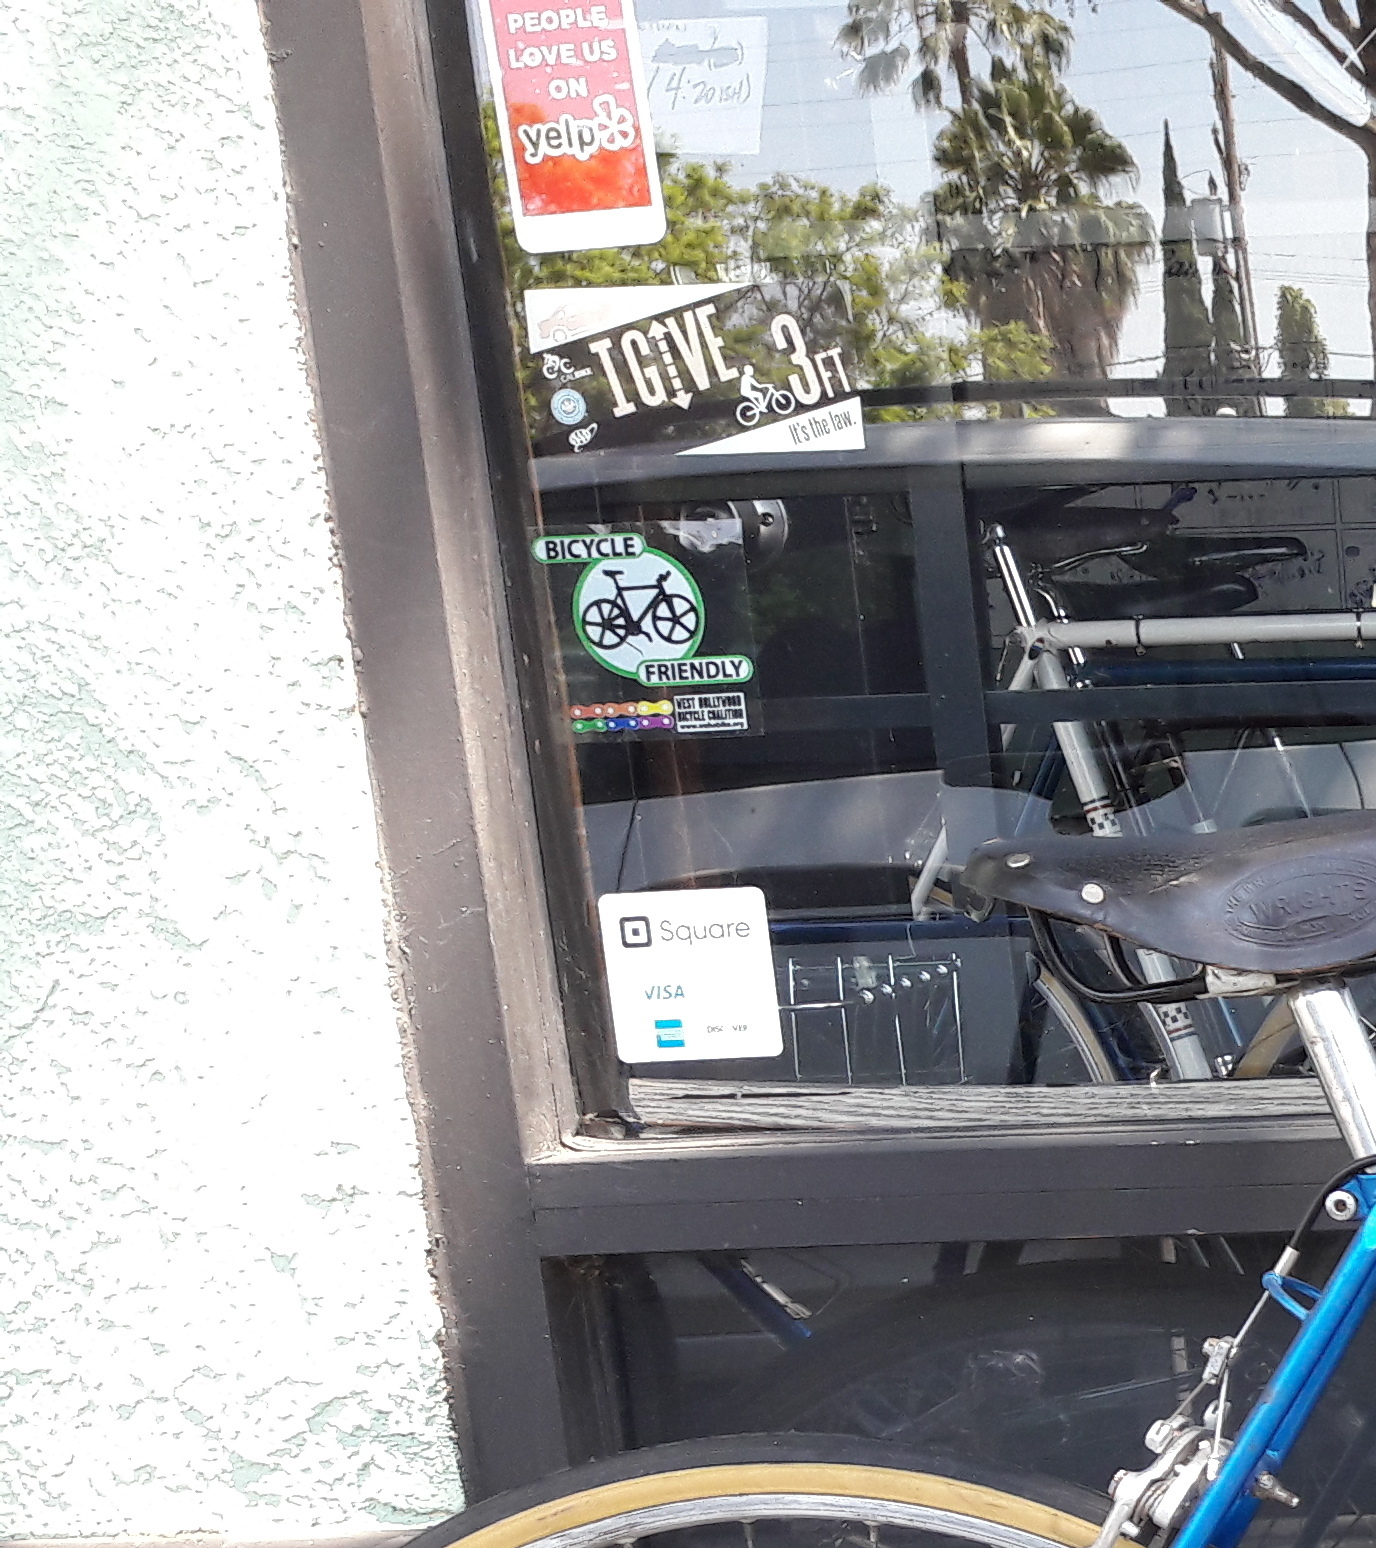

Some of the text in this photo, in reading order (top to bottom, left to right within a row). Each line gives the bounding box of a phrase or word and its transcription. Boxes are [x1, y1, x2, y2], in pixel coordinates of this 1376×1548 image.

[506, 5, 609, 34] PEOPLE
[508, 38, 618, 69] LOVE US
[548, 77, 588, 99] ON
[520, 122, 597, 156] yelp
[588, 303, 852, 419] I GIVE 3 FT
[788, 411, 856, 445] It's the law.
[544, 536, 636, 560] BICYCLE
[644, 660, 745, 683] FRIENDLY
[676, 697, 695, 710] WEST
[660, 920, 750, 945] Square
[645, 984, 685, 1000] VISA
